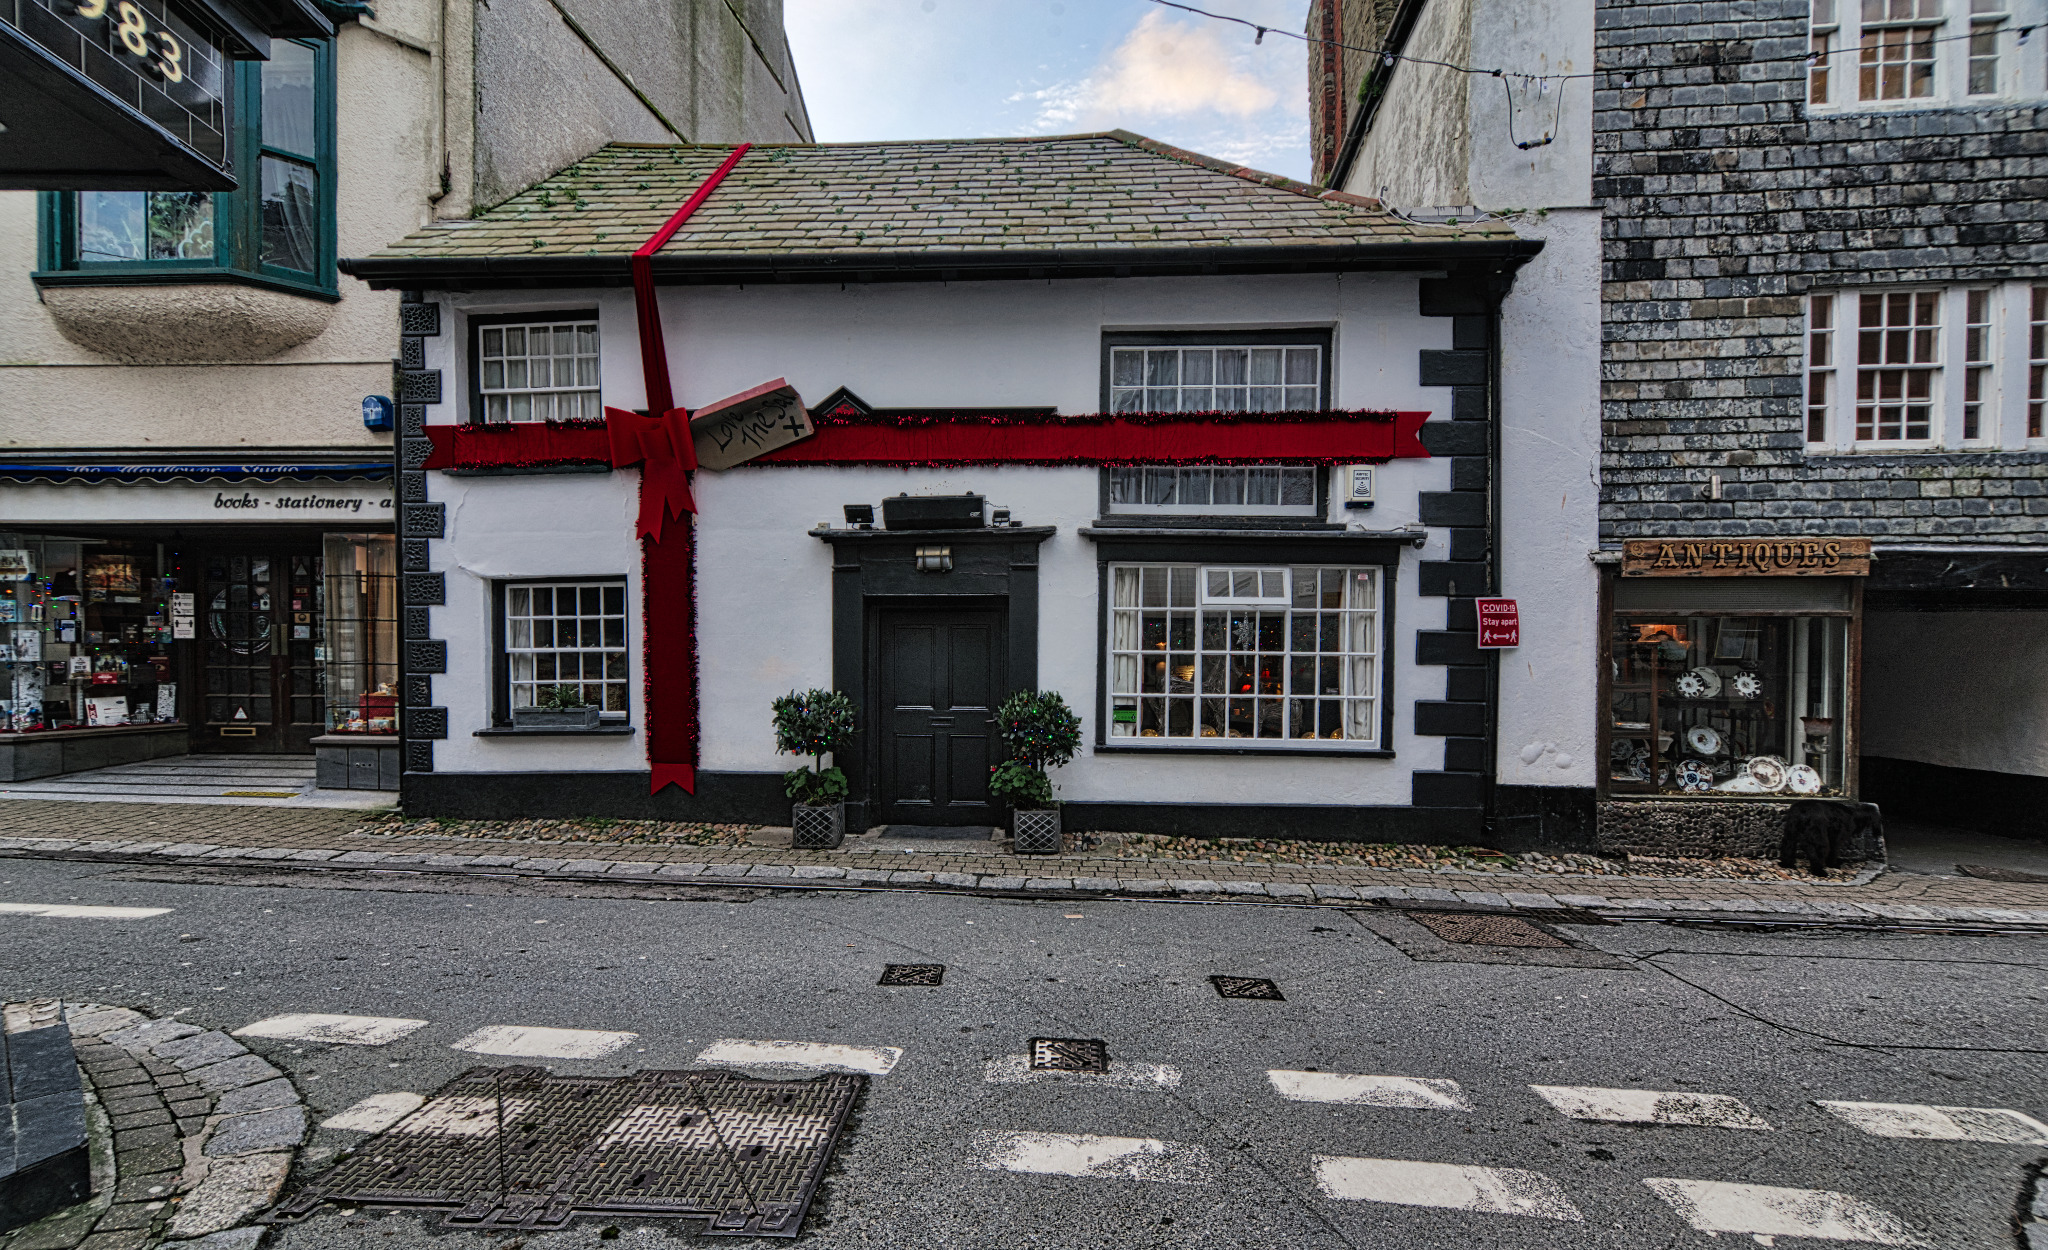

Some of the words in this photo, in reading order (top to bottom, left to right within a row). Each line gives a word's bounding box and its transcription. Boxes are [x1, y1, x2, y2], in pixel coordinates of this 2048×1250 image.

[706, 411, 744, 454] Love
[741, 412, 776, 450] The
[214, 493, 260, 509] books
[275, 495, 363, 513] stationery
[379, 498, 395, 509] a
[1652, 542, 1841, 573] ANTIQUES
[1482, 604, 1516, 612] COVID-19
[1482, 617, 1499, 627] Stay
[1500, 618, 1518, 627] apart
